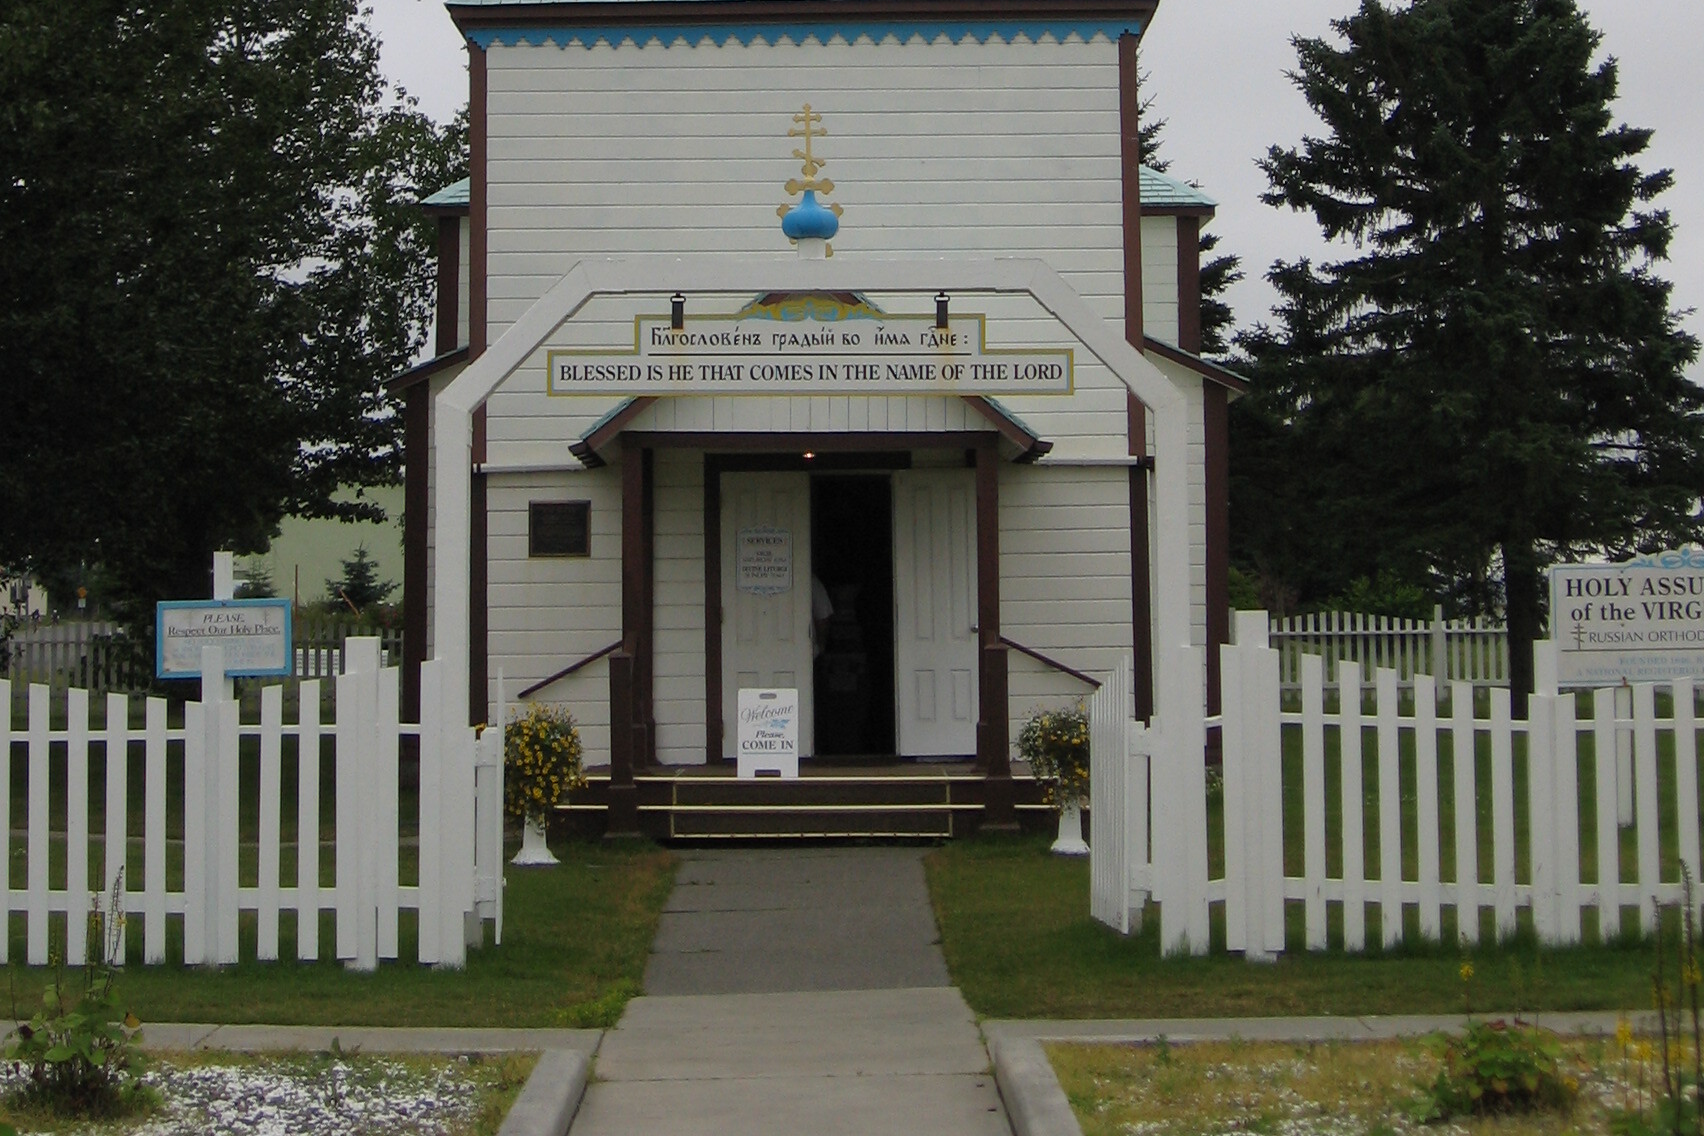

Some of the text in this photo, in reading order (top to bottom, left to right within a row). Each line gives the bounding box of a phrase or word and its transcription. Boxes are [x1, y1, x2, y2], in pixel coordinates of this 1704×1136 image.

[560, 363, 1063, 382] BLESSED IS HE THAT COMES IN THE NAME OF THE LORD
[1566, 577, 1632, 597] HOLY
[1571, 600, 1702, 622] of the VIRG
[168, 626, 206, 637] Respect
[208, 625, 228, 635] Our
[230, 625, 252, 635] Holy
[1589, 630, 1644, 643] RUSSIAN
[1585, 667, 1633, 676] NATIONAL
[741, 704, 794, 724] Welcome
[742, 739, 794, 751] COME IN
